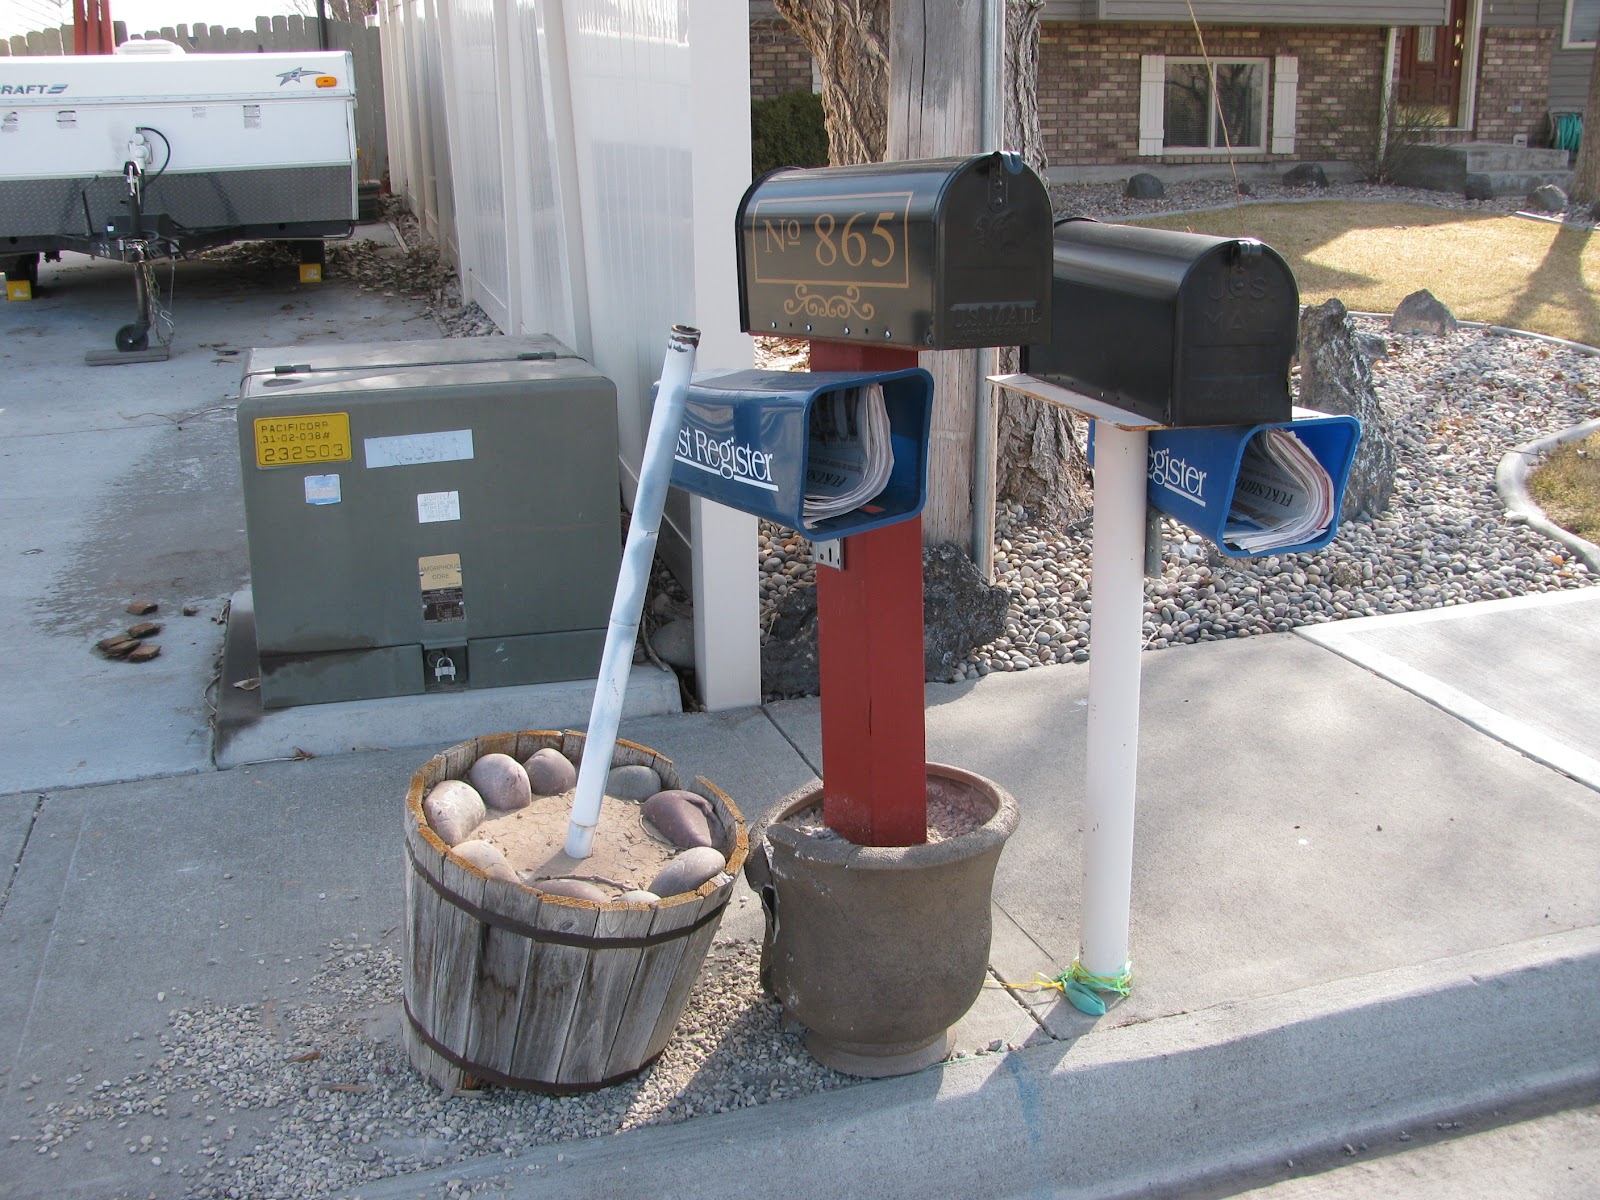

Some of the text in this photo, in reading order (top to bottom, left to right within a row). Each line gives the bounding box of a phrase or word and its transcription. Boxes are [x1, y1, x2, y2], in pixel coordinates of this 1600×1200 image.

[0, 84, 48, 95] RAFT
[814, 211, 896, 267] 865
[261, 420, 329, 433] PACIFICORP
[264, 443, 344, 462] 232503
[676, 426, 692, 458] st
[695, 428, 773, 482] Register
[420, 562, 460, 572] AMORPHOUS
[431, 572, 450, 580] CORE
